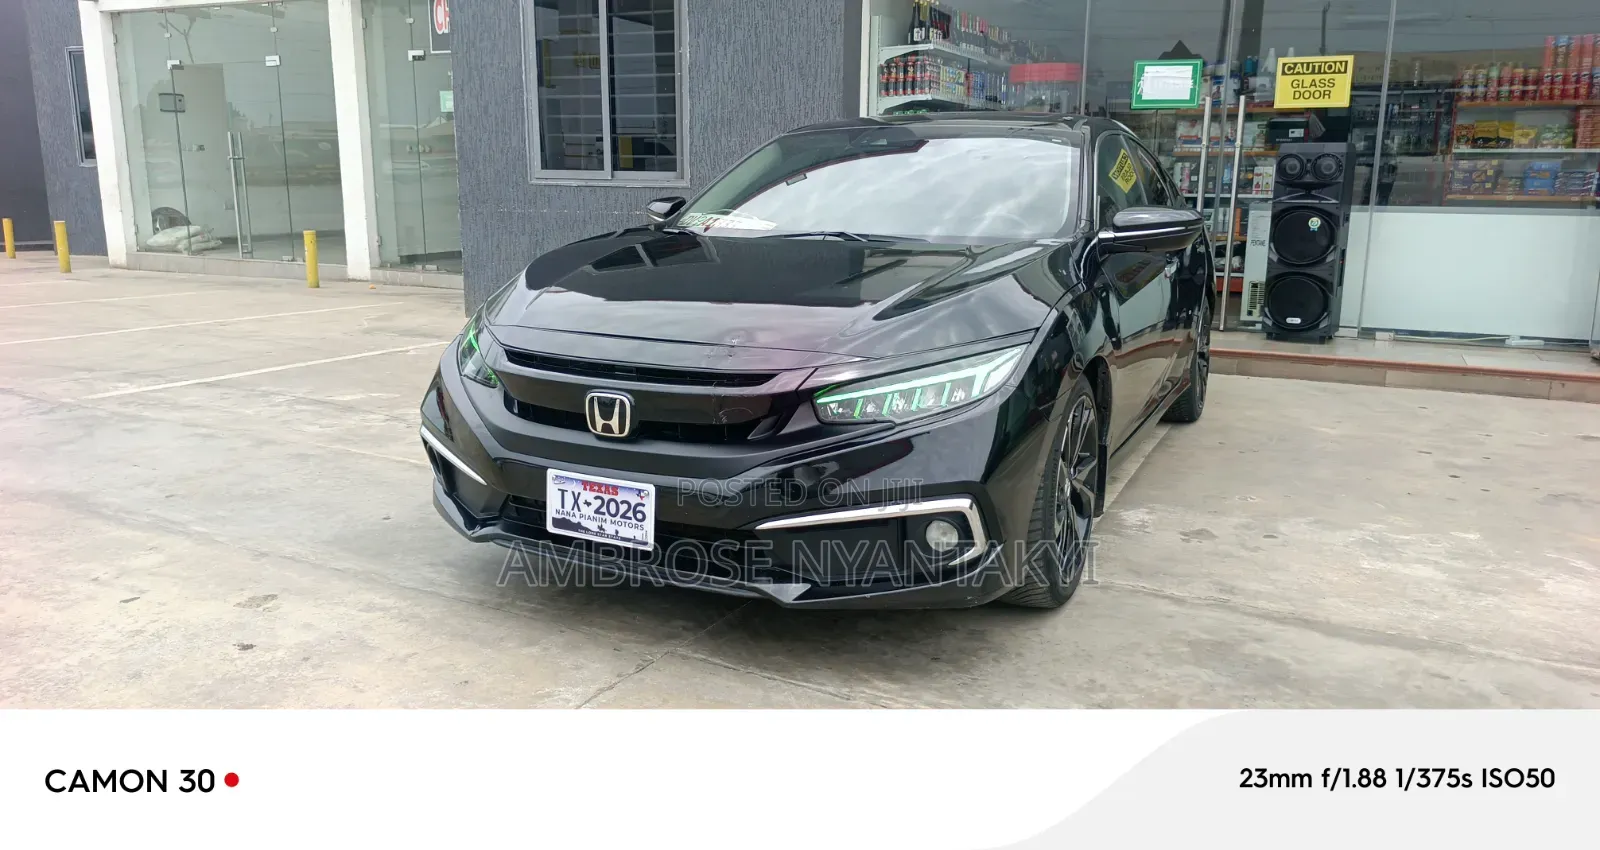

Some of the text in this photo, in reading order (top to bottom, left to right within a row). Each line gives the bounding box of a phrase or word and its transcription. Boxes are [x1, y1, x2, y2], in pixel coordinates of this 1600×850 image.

[1284, 61, 1346, 74] CAUTION
[1291, 78, 1336, 89] GLASS
[1292, 90, 1332, 100] DOOR
[581, 480, 619, 496] TEXAS
[557, 488, 646, 522] TX 2026
[555, 508, 645, 531] NANA PIANIM MOTORS
